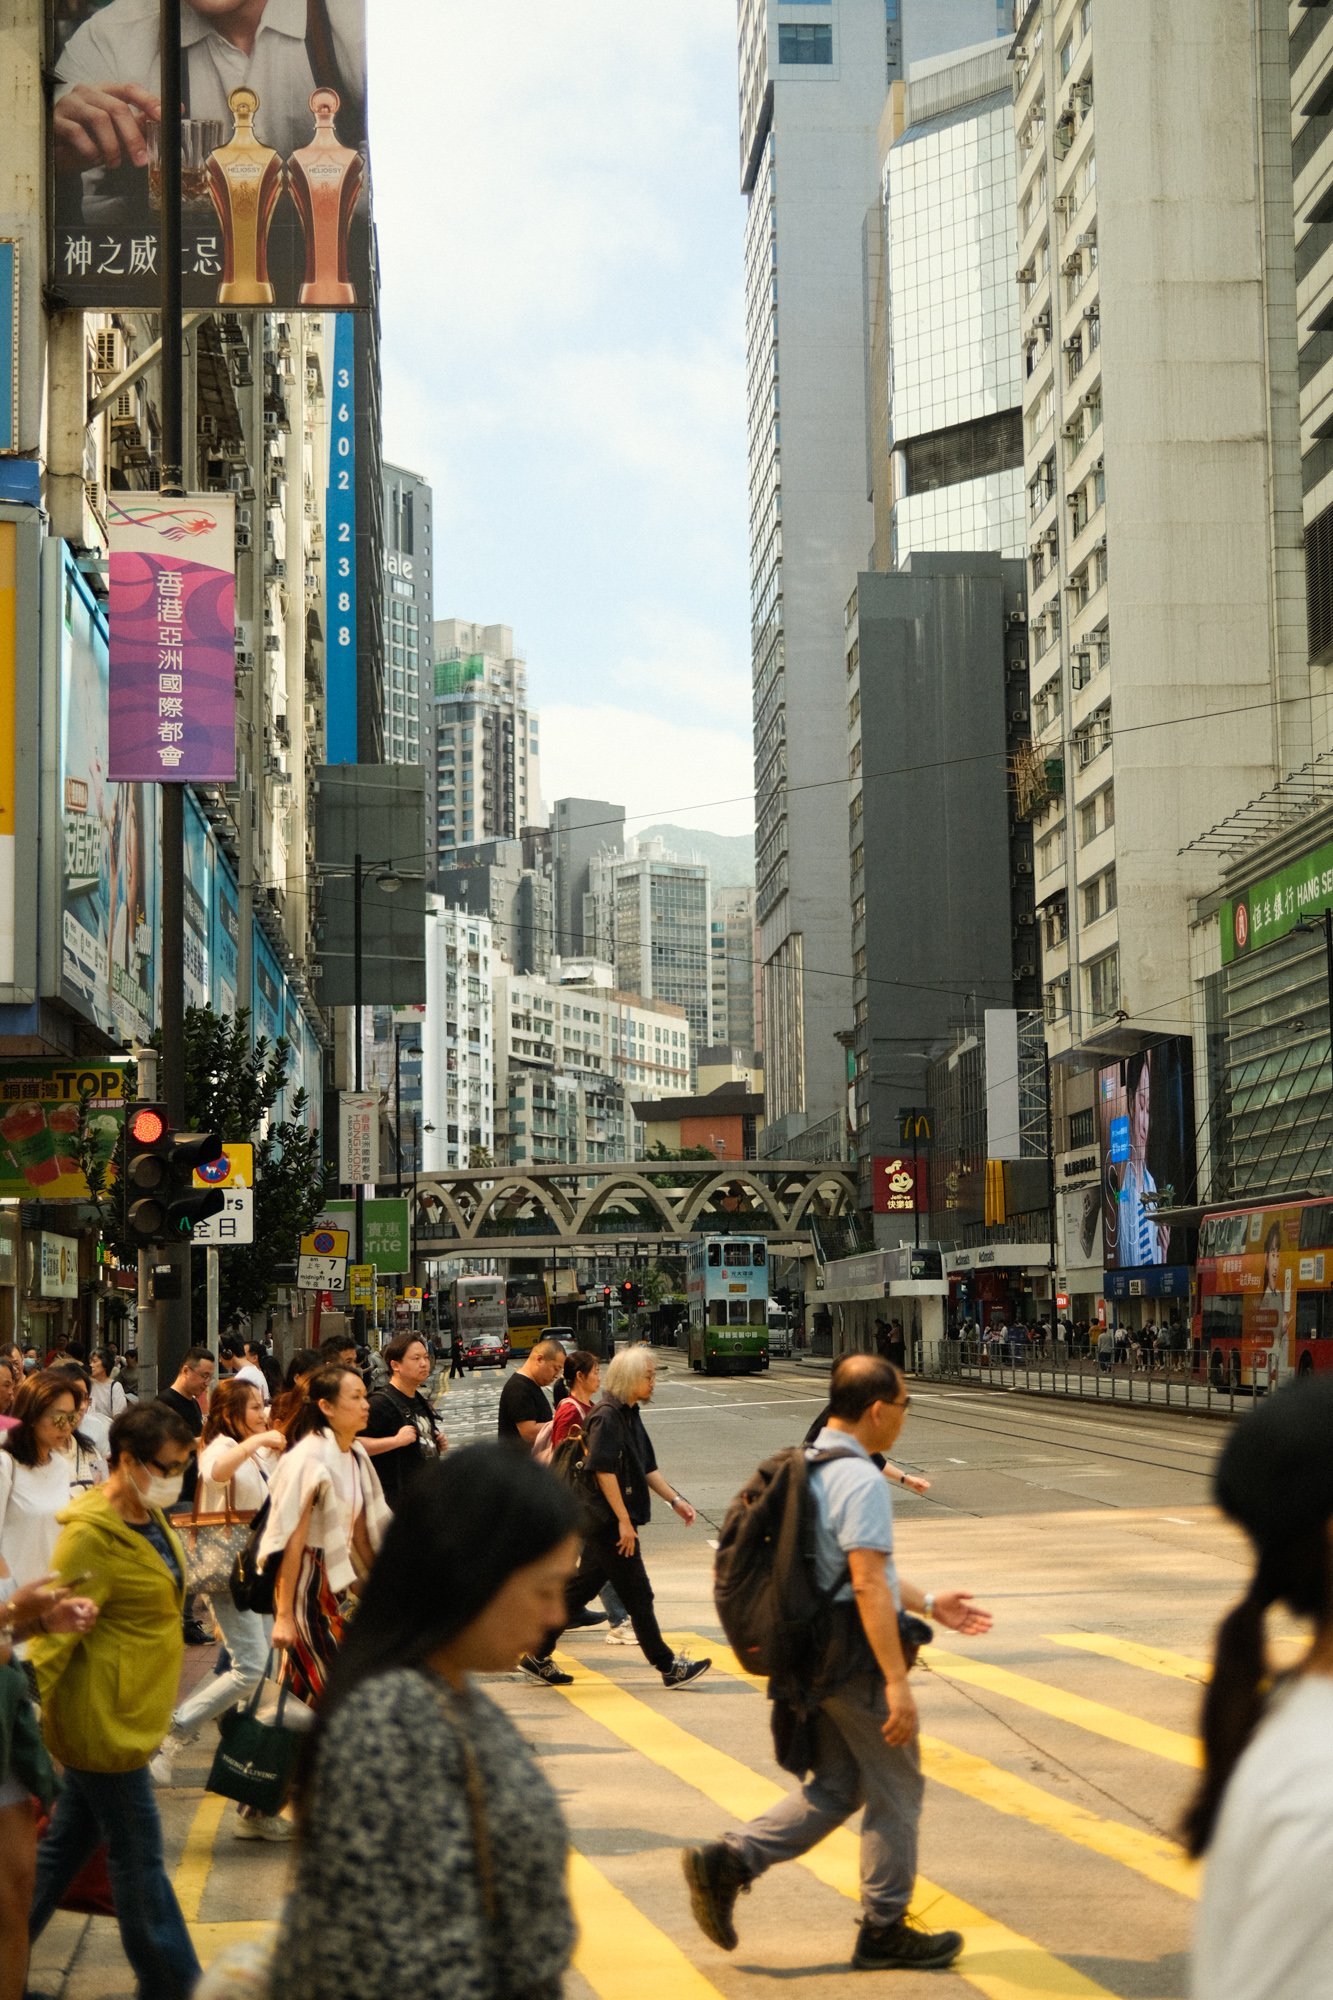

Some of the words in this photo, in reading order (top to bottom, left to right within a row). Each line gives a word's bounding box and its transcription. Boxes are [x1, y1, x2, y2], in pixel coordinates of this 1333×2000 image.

[64, 235, 222, 275] 神之威忌
[338, 369, 350, 490] 3602
[338, 523, 351, 646] 2388
[156, 570, 184, 767] 香港亞洲國際都會
[1297, 876, 1320, 907] HANG
[1321, 868, 1333, 895] SE
[56, 1071, 120, 1099] TOP
[353, 1114, 361, 1147] HONG
[353, 1148, 361, 1181] KONG
[328, 1259, 337, 1271] 7
[328, 1277, 342, 1289] 12
[222, 1753, 245, 1770] YOUNG
[249, 1769, 278, 1780] LIVING
